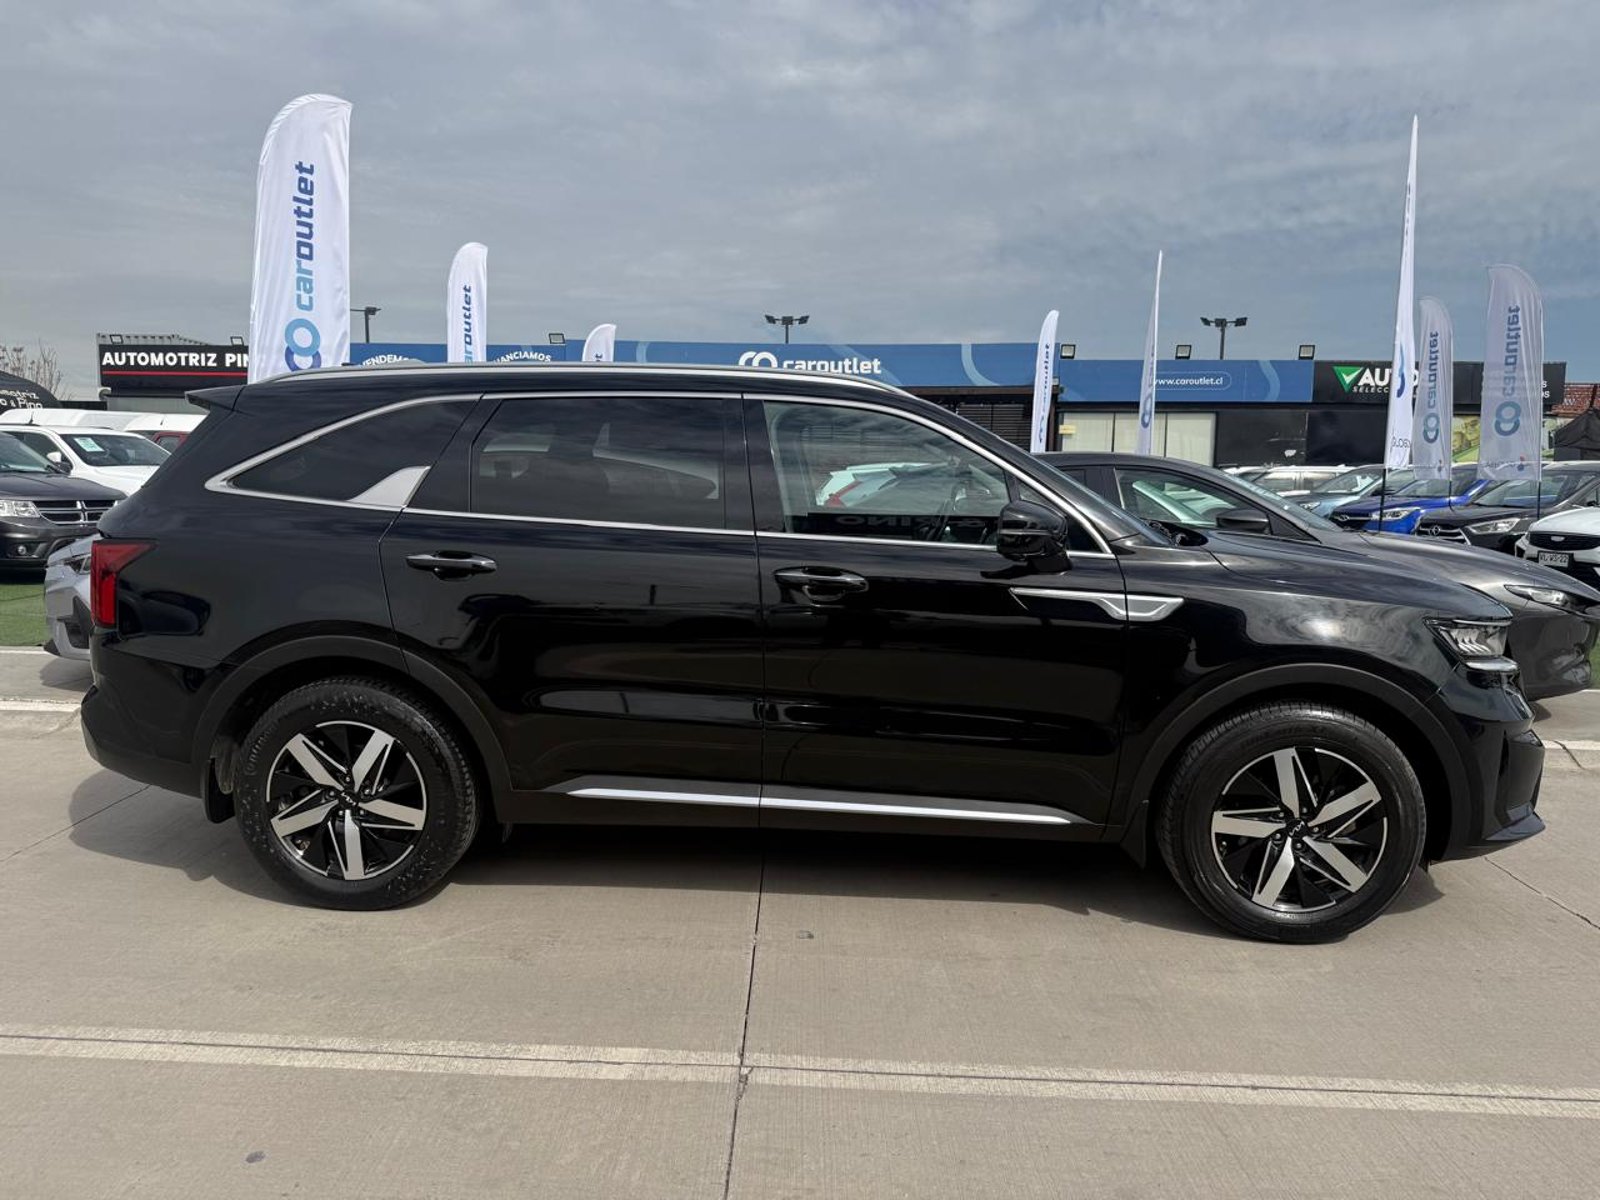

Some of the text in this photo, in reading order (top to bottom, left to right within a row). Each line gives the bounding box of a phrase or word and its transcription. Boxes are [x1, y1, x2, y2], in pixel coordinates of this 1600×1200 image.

[293, 161, 315, 312] caroutlet
[462, 284, 473, 363] aroutlet
[102, 352, 217, 367] AUTOMOTRIZ
[783, 357, 881, 374] caroutlet
